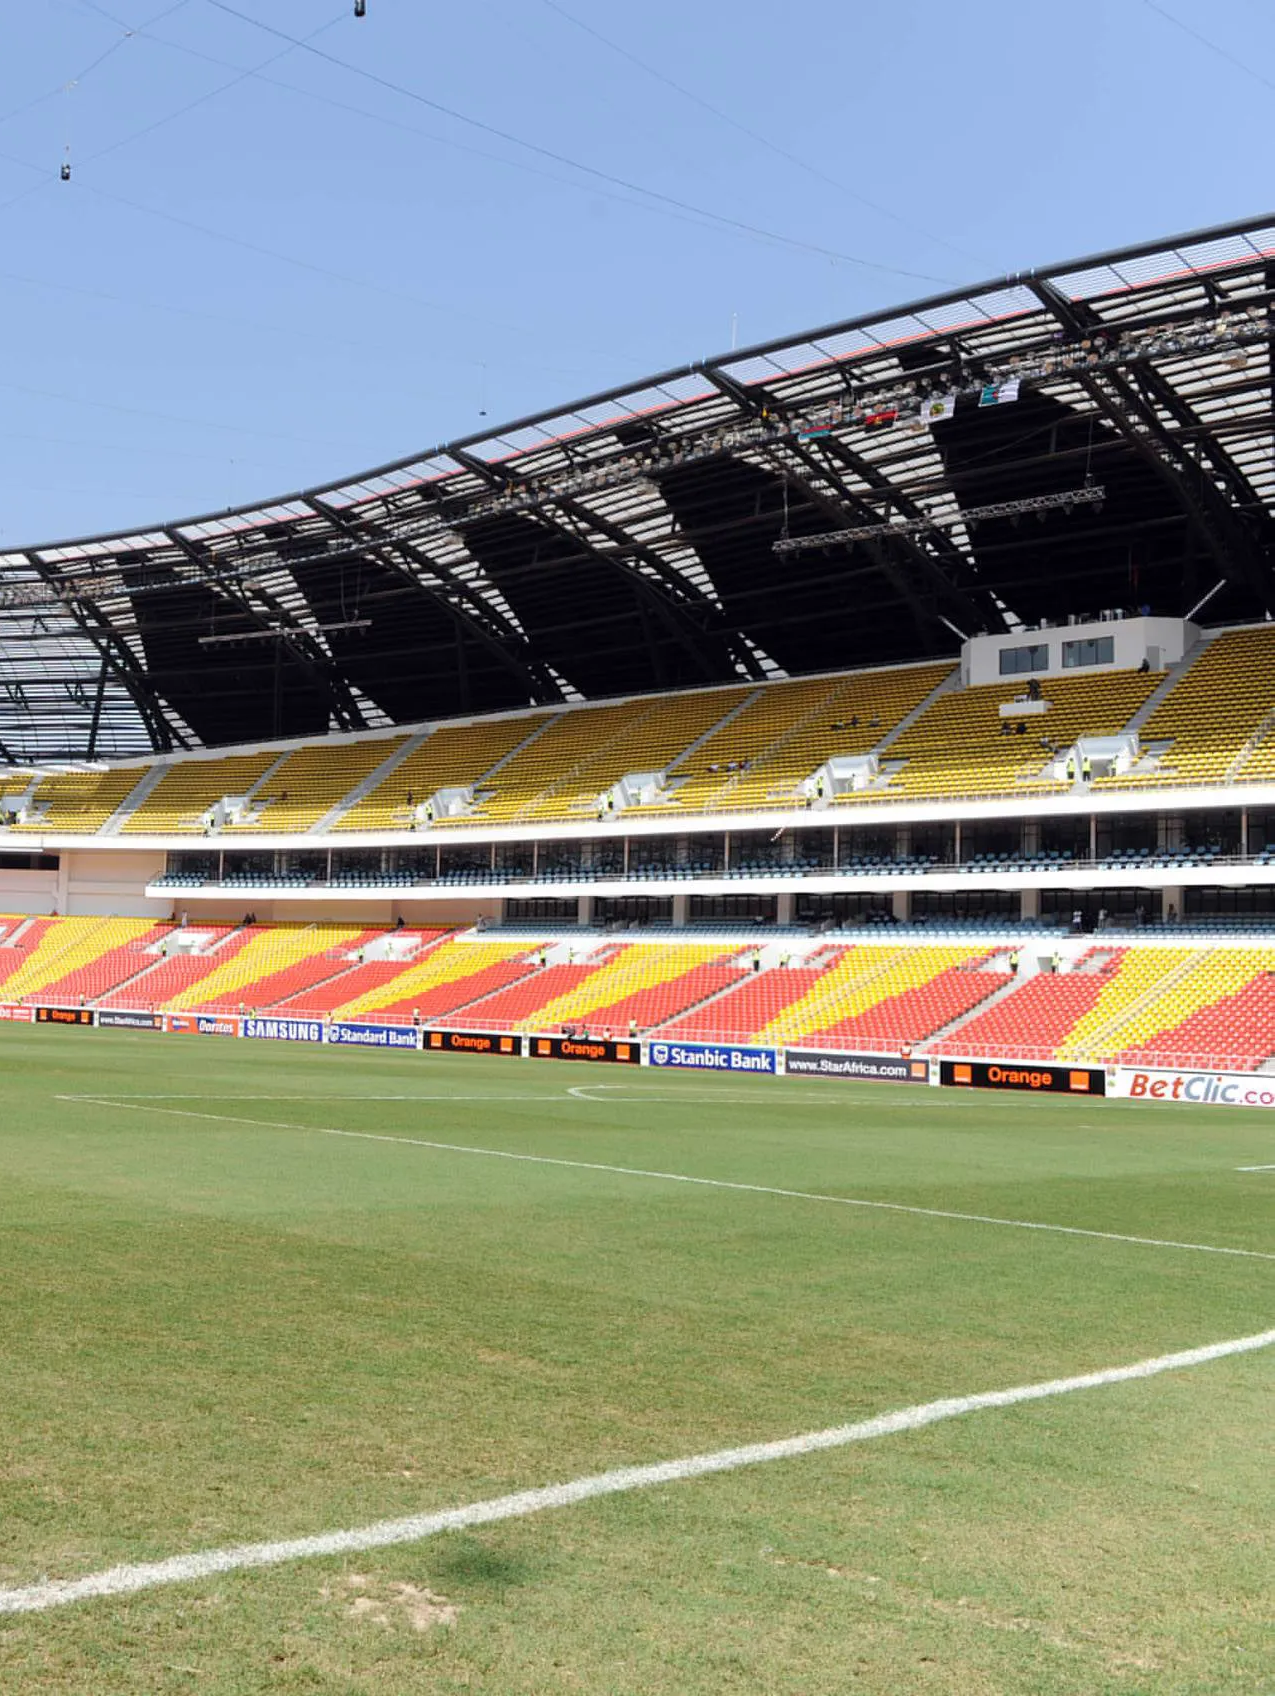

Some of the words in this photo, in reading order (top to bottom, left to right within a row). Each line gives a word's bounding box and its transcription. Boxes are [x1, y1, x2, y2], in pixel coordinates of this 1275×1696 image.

[247, 1020, 319, 1040] SAMSUNG
[340, 1027, 386, 1044] Standard
[389, 1031, 416, 1046] Bank
[451, 1035, 491, 1050] Orange
[561, 1042, 605, 1057] Orange
[671, 1048, 728, 1067] Stanbic
[731, 1051, 772, 1070] Bank
[789, 1059, 907, 1077] www.StarAfrica.com
[988, 1066, 1053, 1086] Orange
